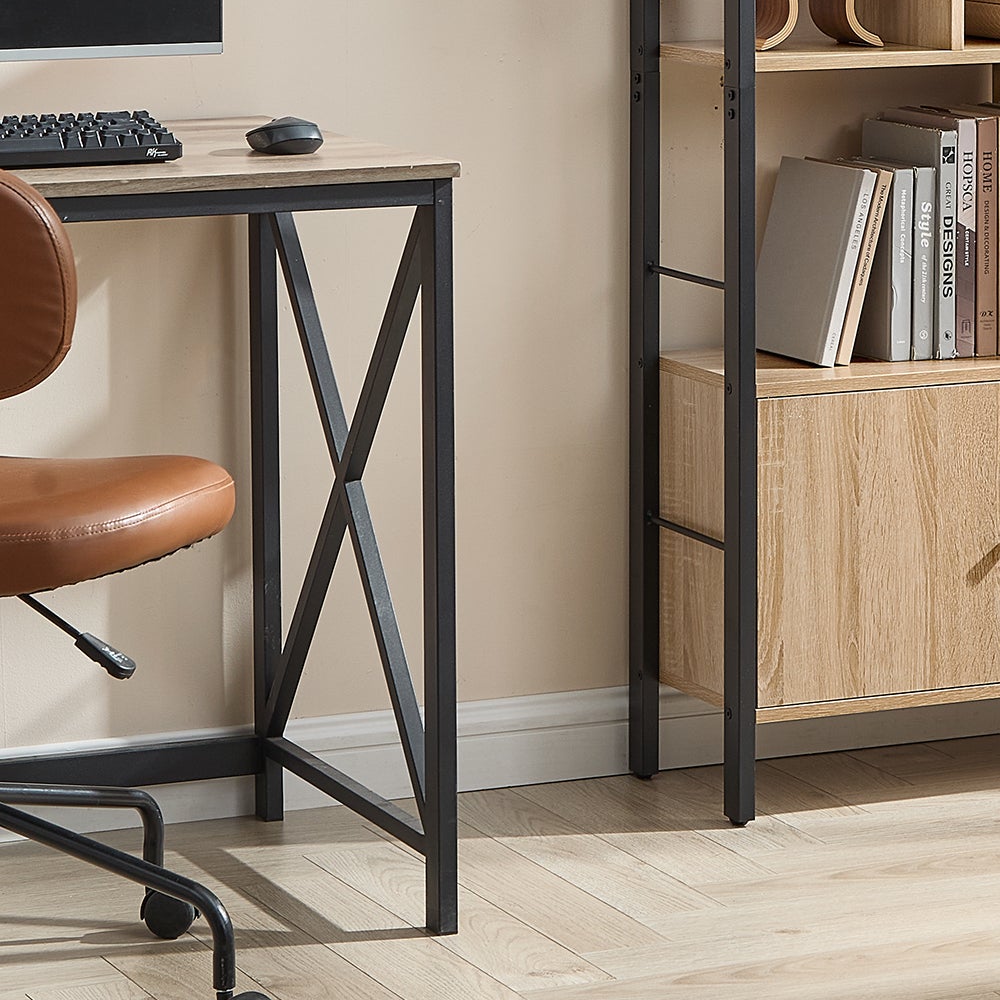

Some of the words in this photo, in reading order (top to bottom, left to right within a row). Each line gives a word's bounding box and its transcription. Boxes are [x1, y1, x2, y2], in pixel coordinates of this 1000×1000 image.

[962, 151, 974, 212] HOPSCA
[982, 151, 993, 193] HOME
[860, 193, 869, 210] LOS
[875, 195, 884, 218] Modern
[851, 212, 864, 250] ANGELES
[918, 201, 933, 248] Style
[943, 216, 954, 298] DESIGNS
